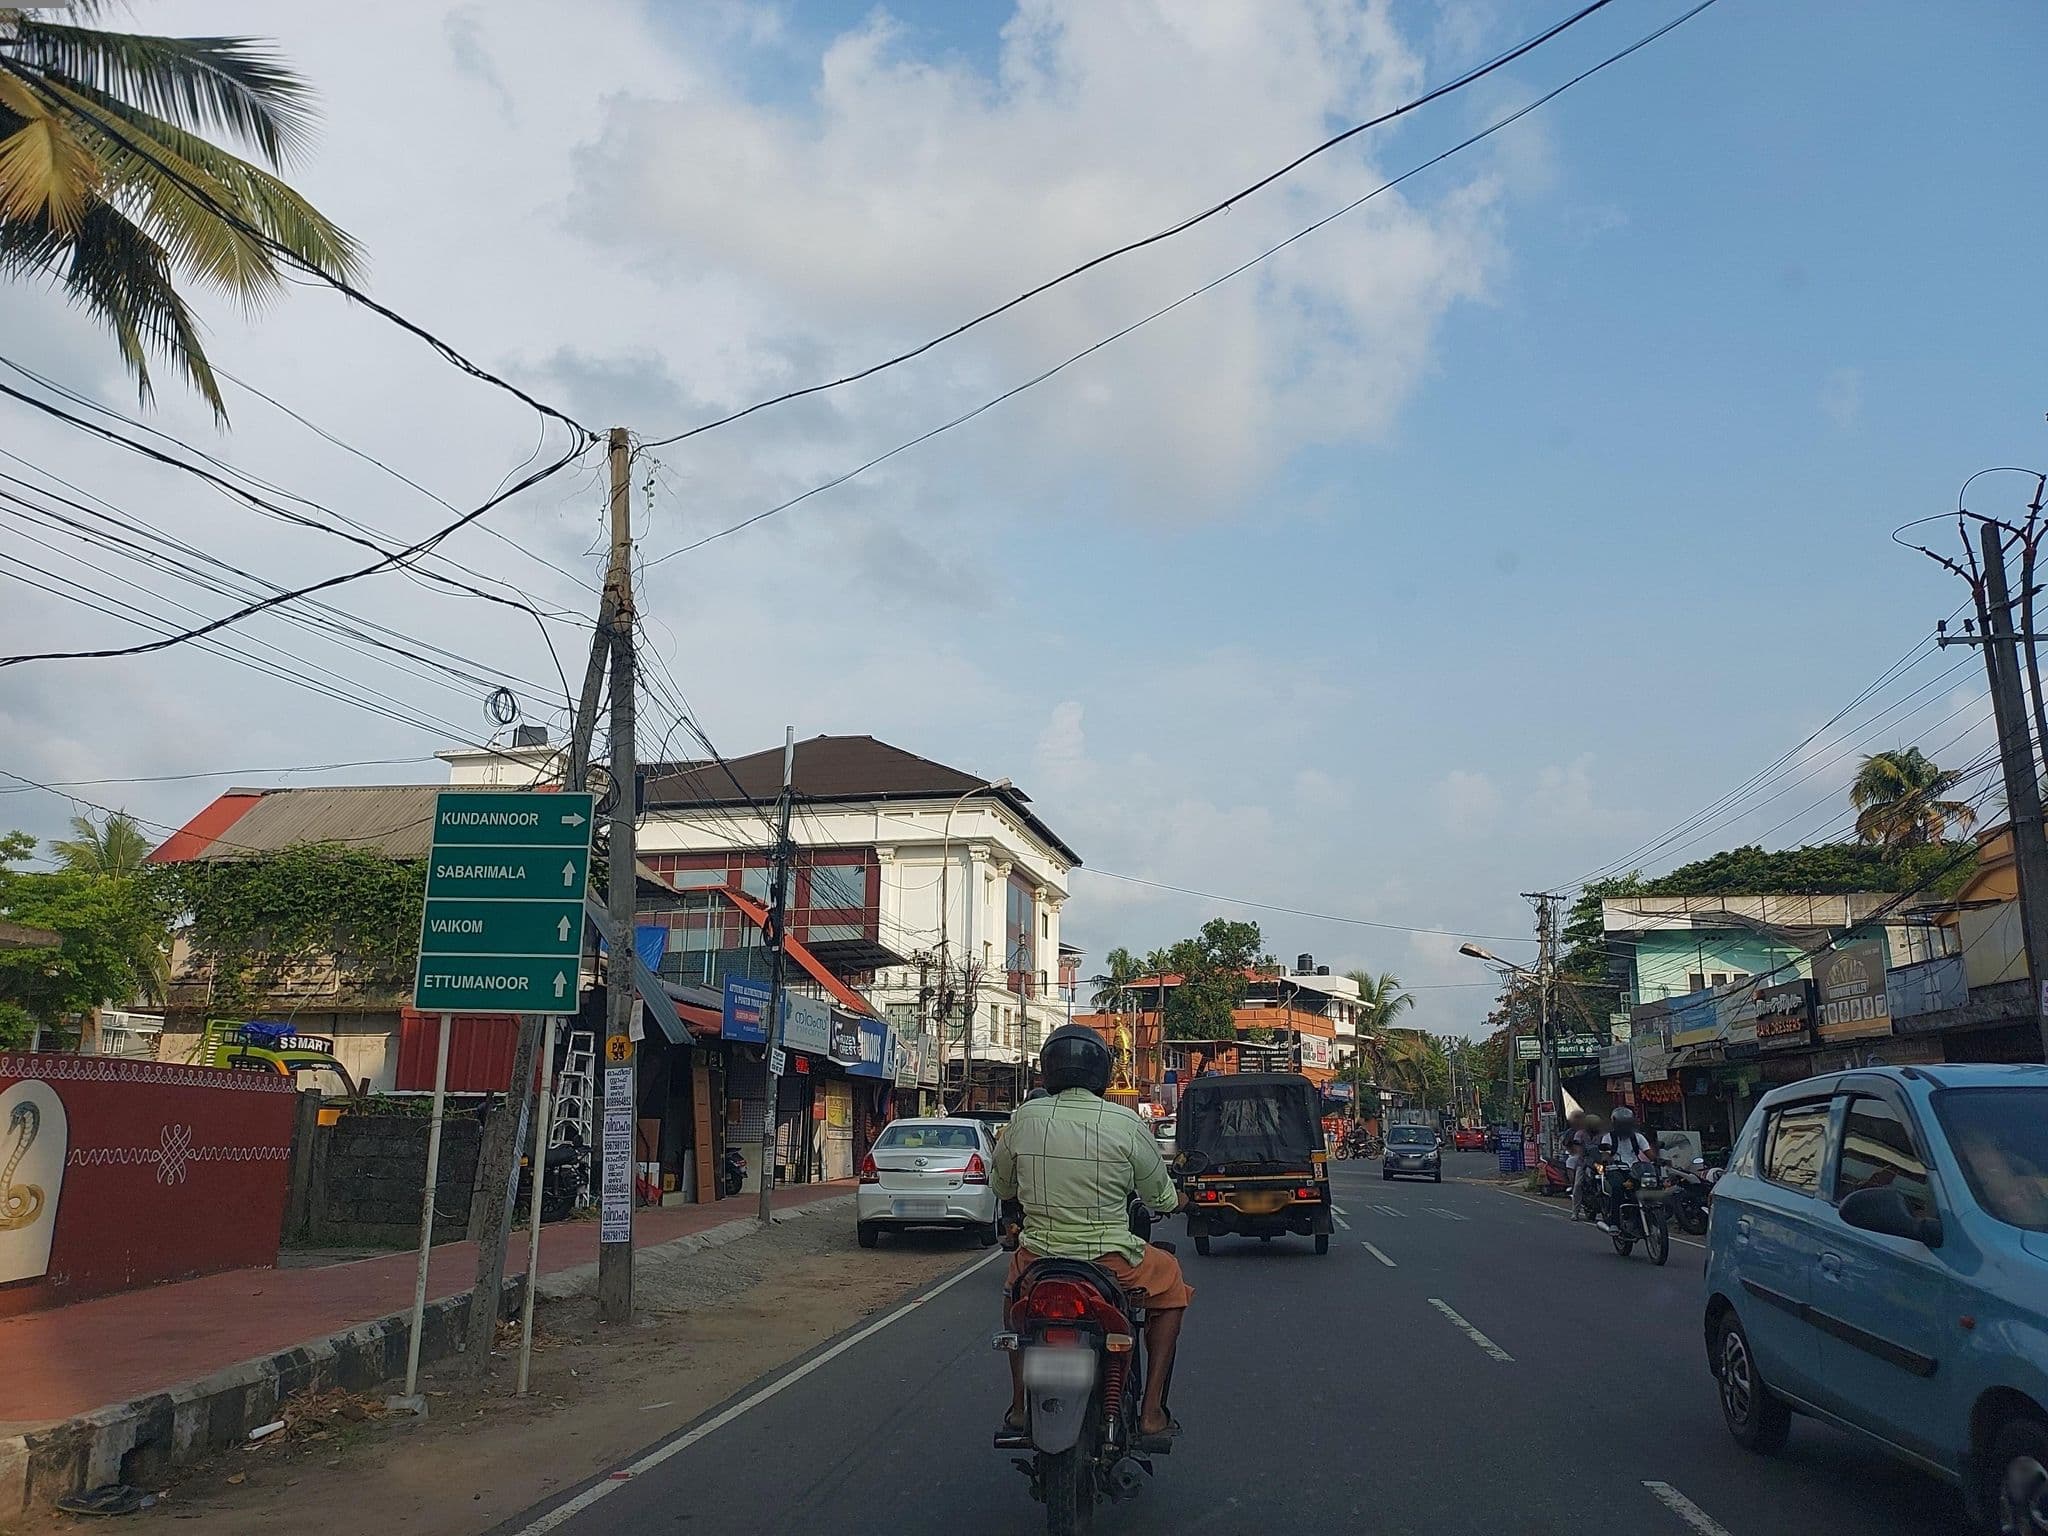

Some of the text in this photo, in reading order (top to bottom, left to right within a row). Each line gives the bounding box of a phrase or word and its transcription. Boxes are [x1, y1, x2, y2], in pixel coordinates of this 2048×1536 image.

[441, 812, 539, 827] KUNDANNOOR
[436, 865, 526, 880] SABARIMALA
[430, 919, 483, 934] VAIKOM
[424, 974, 529, 991] ETTUMANOOR
